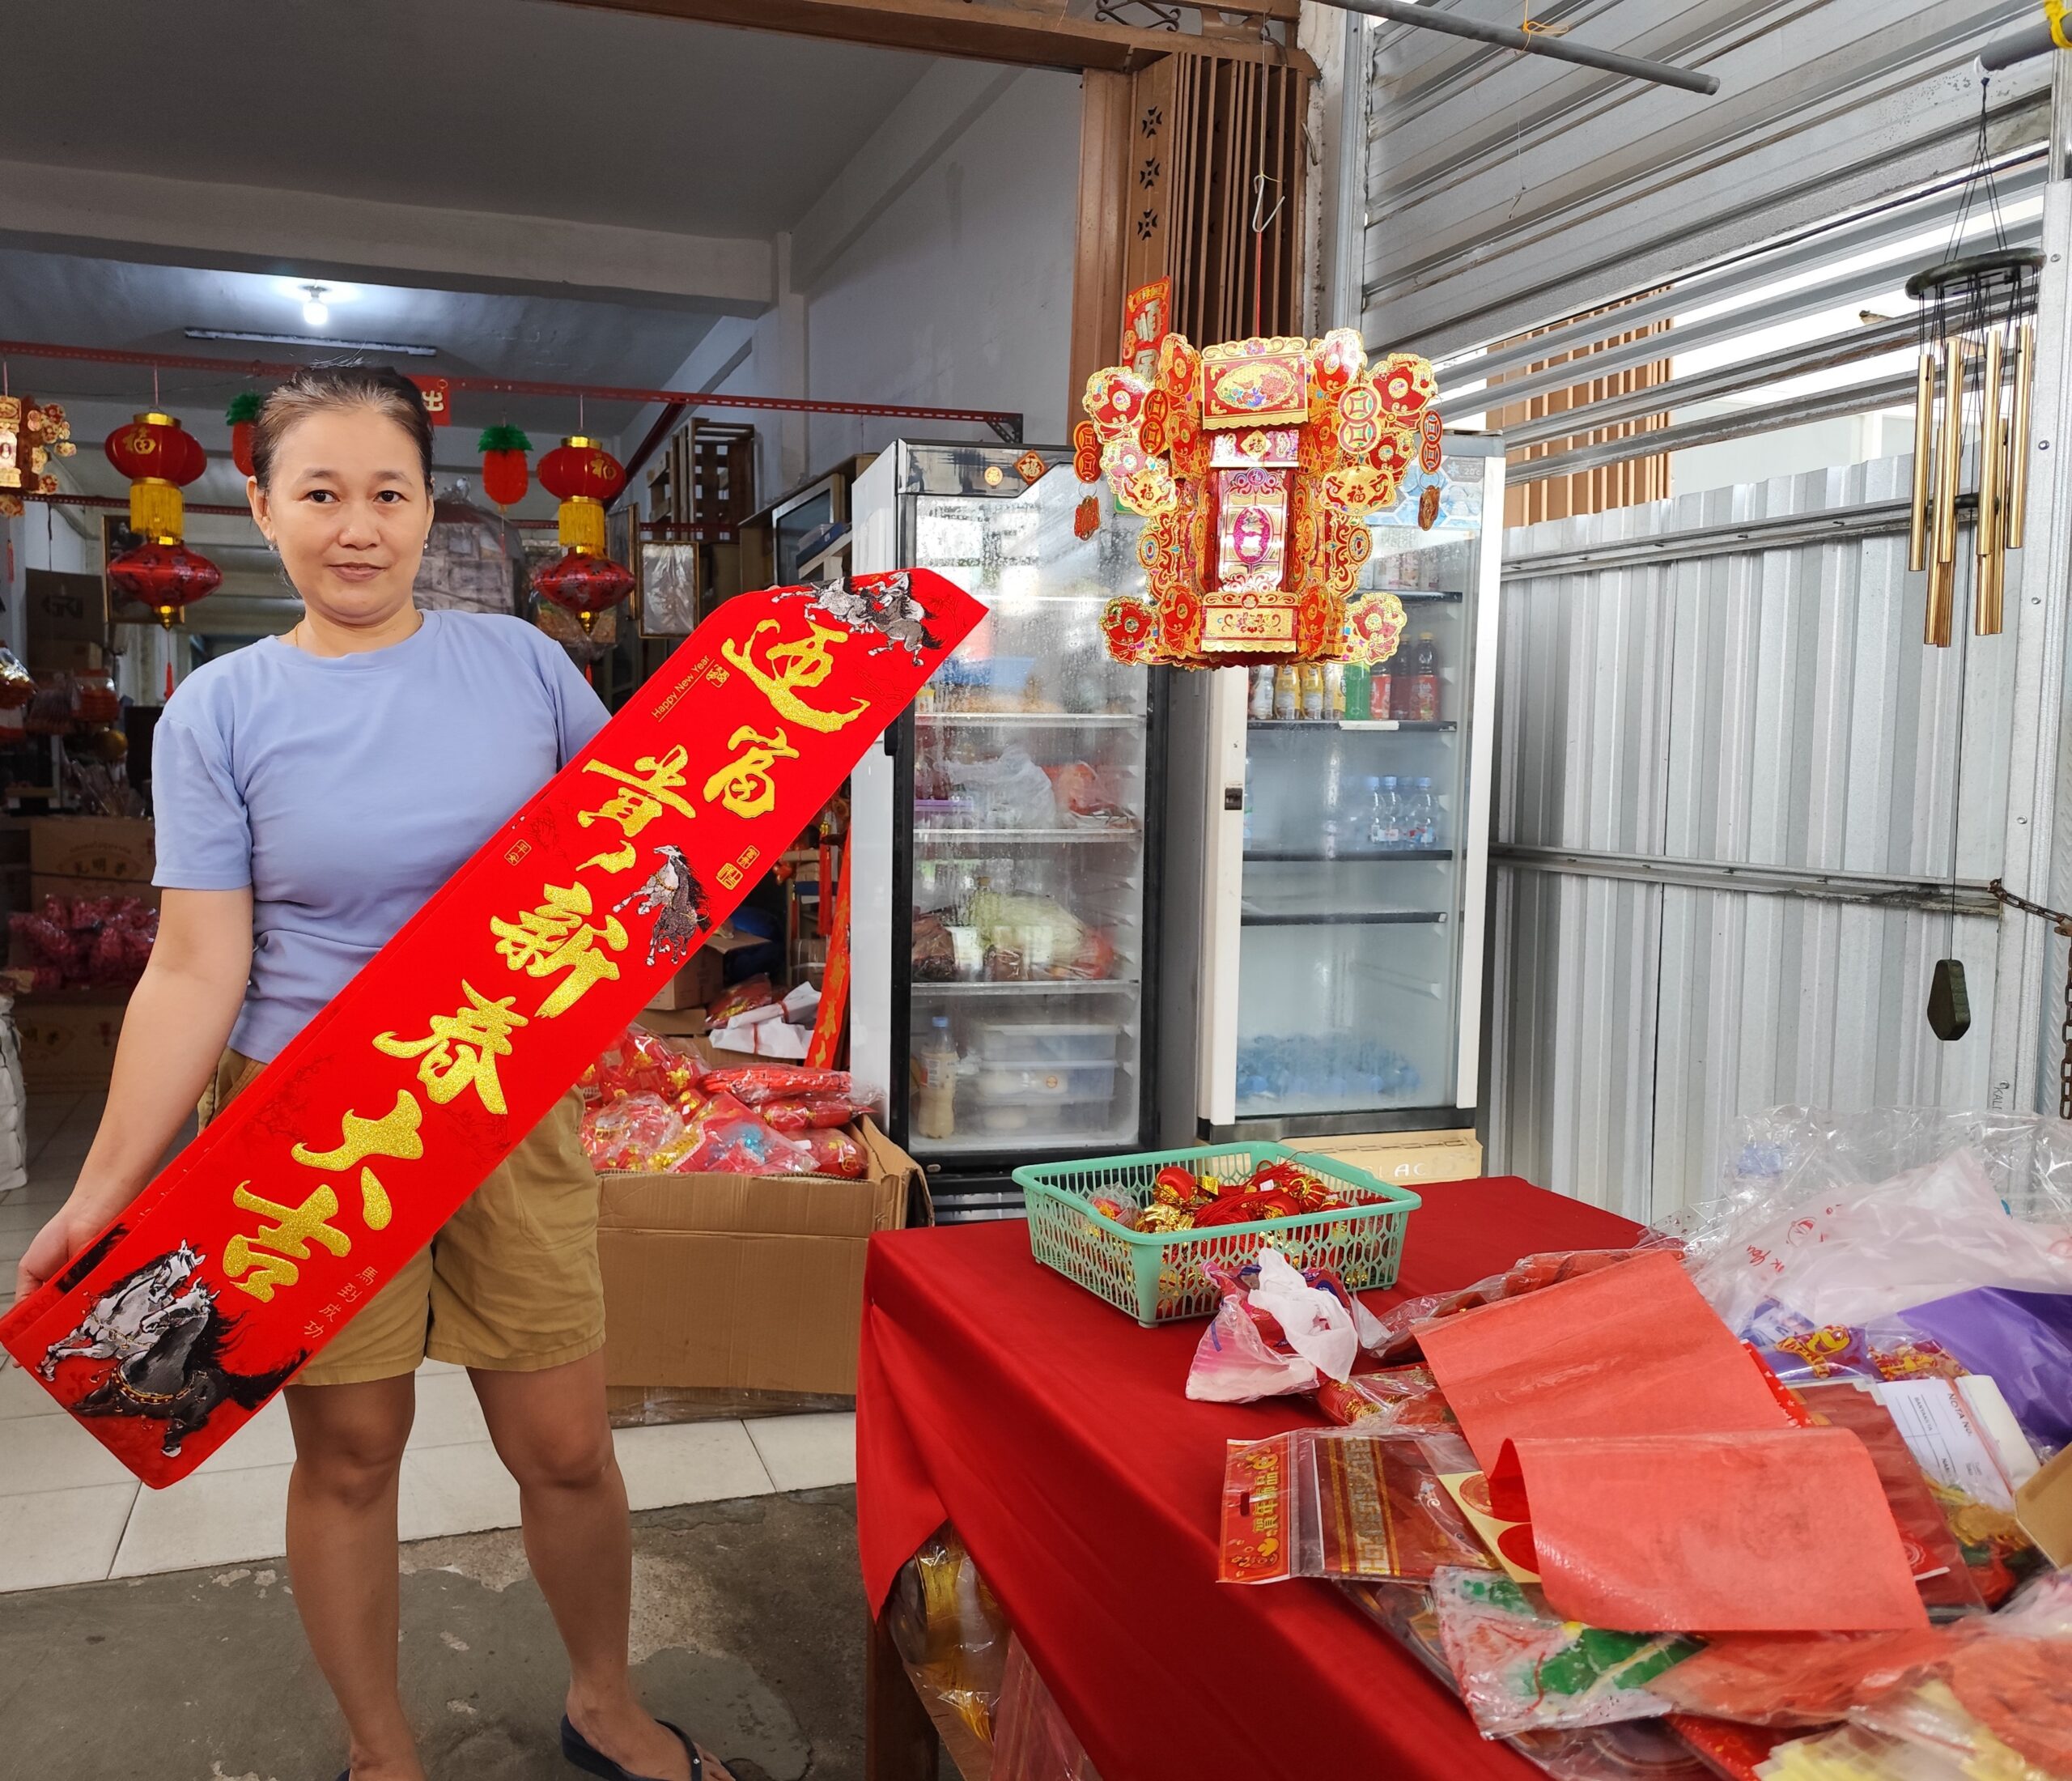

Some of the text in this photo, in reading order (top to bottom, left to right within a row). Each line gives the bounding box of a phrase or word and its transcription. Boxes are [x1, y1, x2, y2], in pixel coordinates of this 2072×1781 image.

[122, 427, 156, 455] 福
[1347, 484, 1365, 503] 福
[651, 654, 711, 719] Happy New Year
[505, 840, 530, 865] 平安
[303, 1265, 379, 1341] 馬到成功
[1947, 1392, 1964, 1419] NOTA
